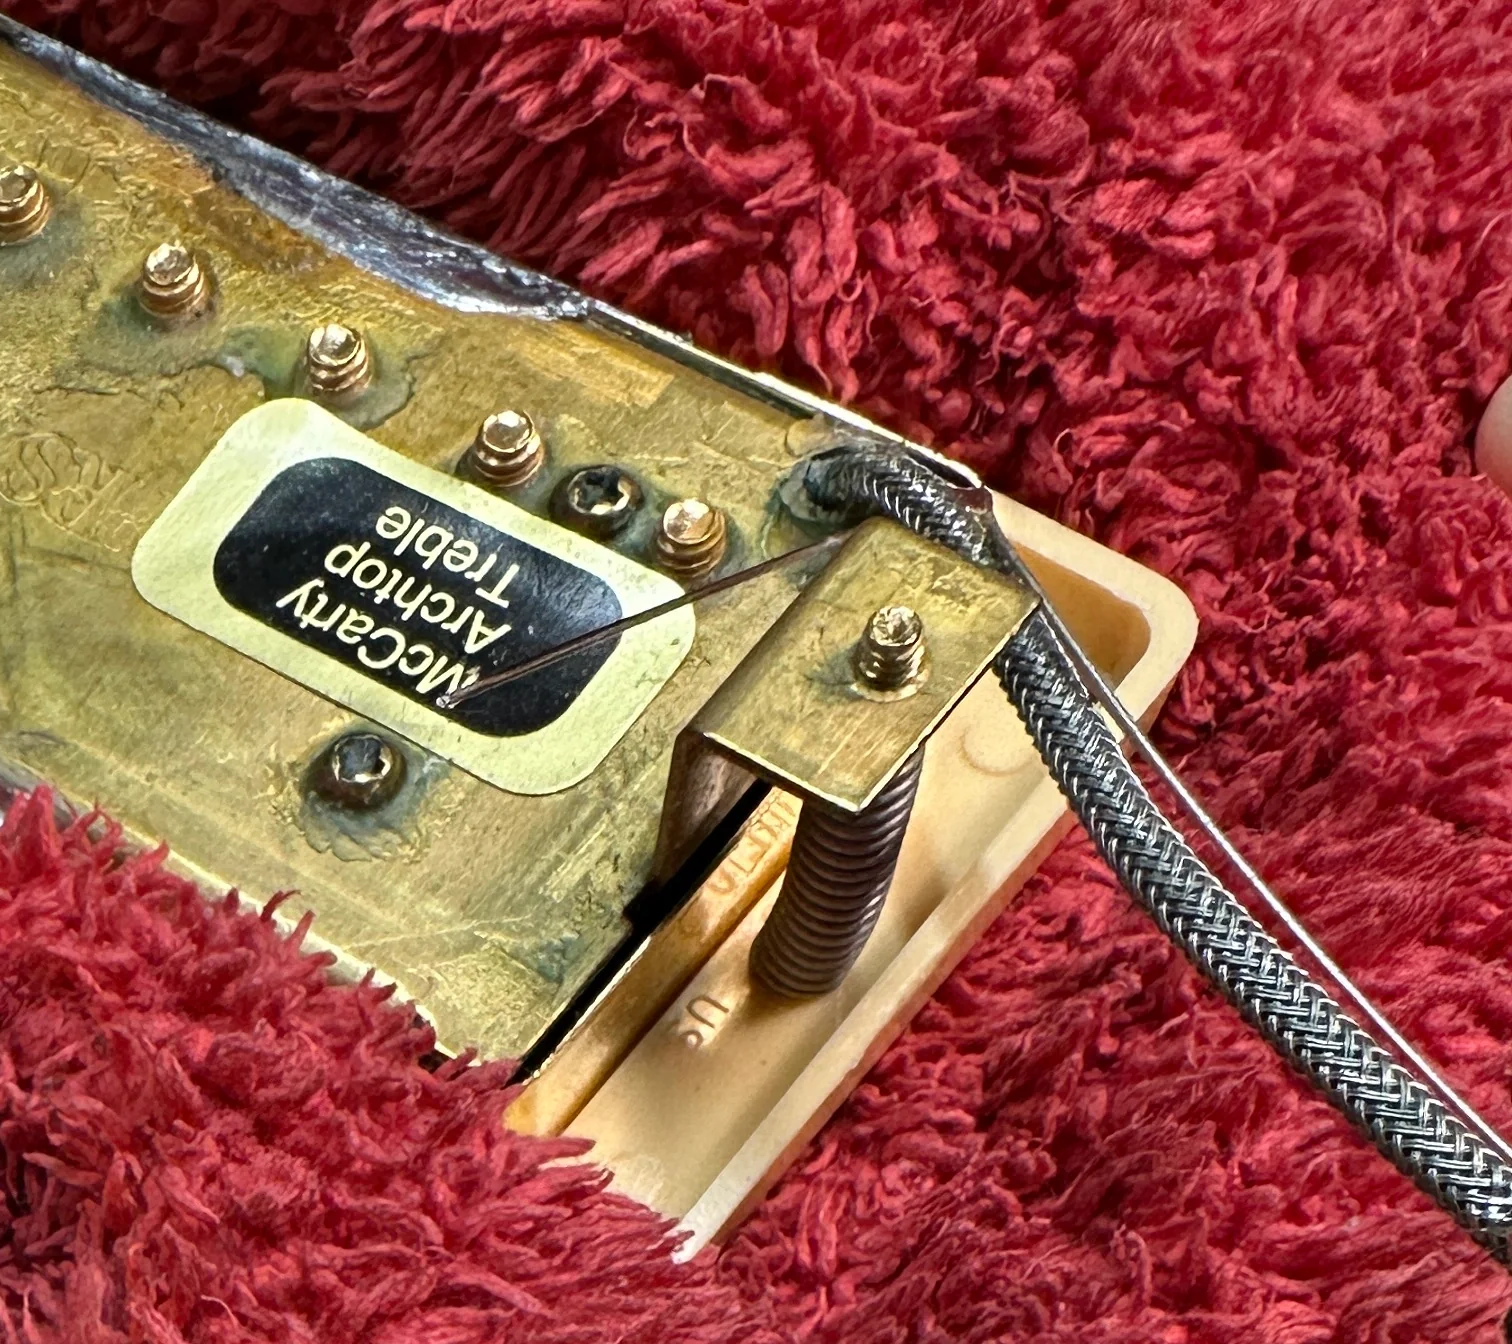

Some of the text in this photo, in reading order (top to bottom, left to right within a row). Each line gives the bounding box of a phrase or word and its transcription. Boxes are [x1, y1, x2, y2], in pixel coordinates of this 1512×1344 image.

[324, 540, 513, 656] Archtop
[374, 504, 521, 609] Treble
[275, 579, 483, 698] McCarty
